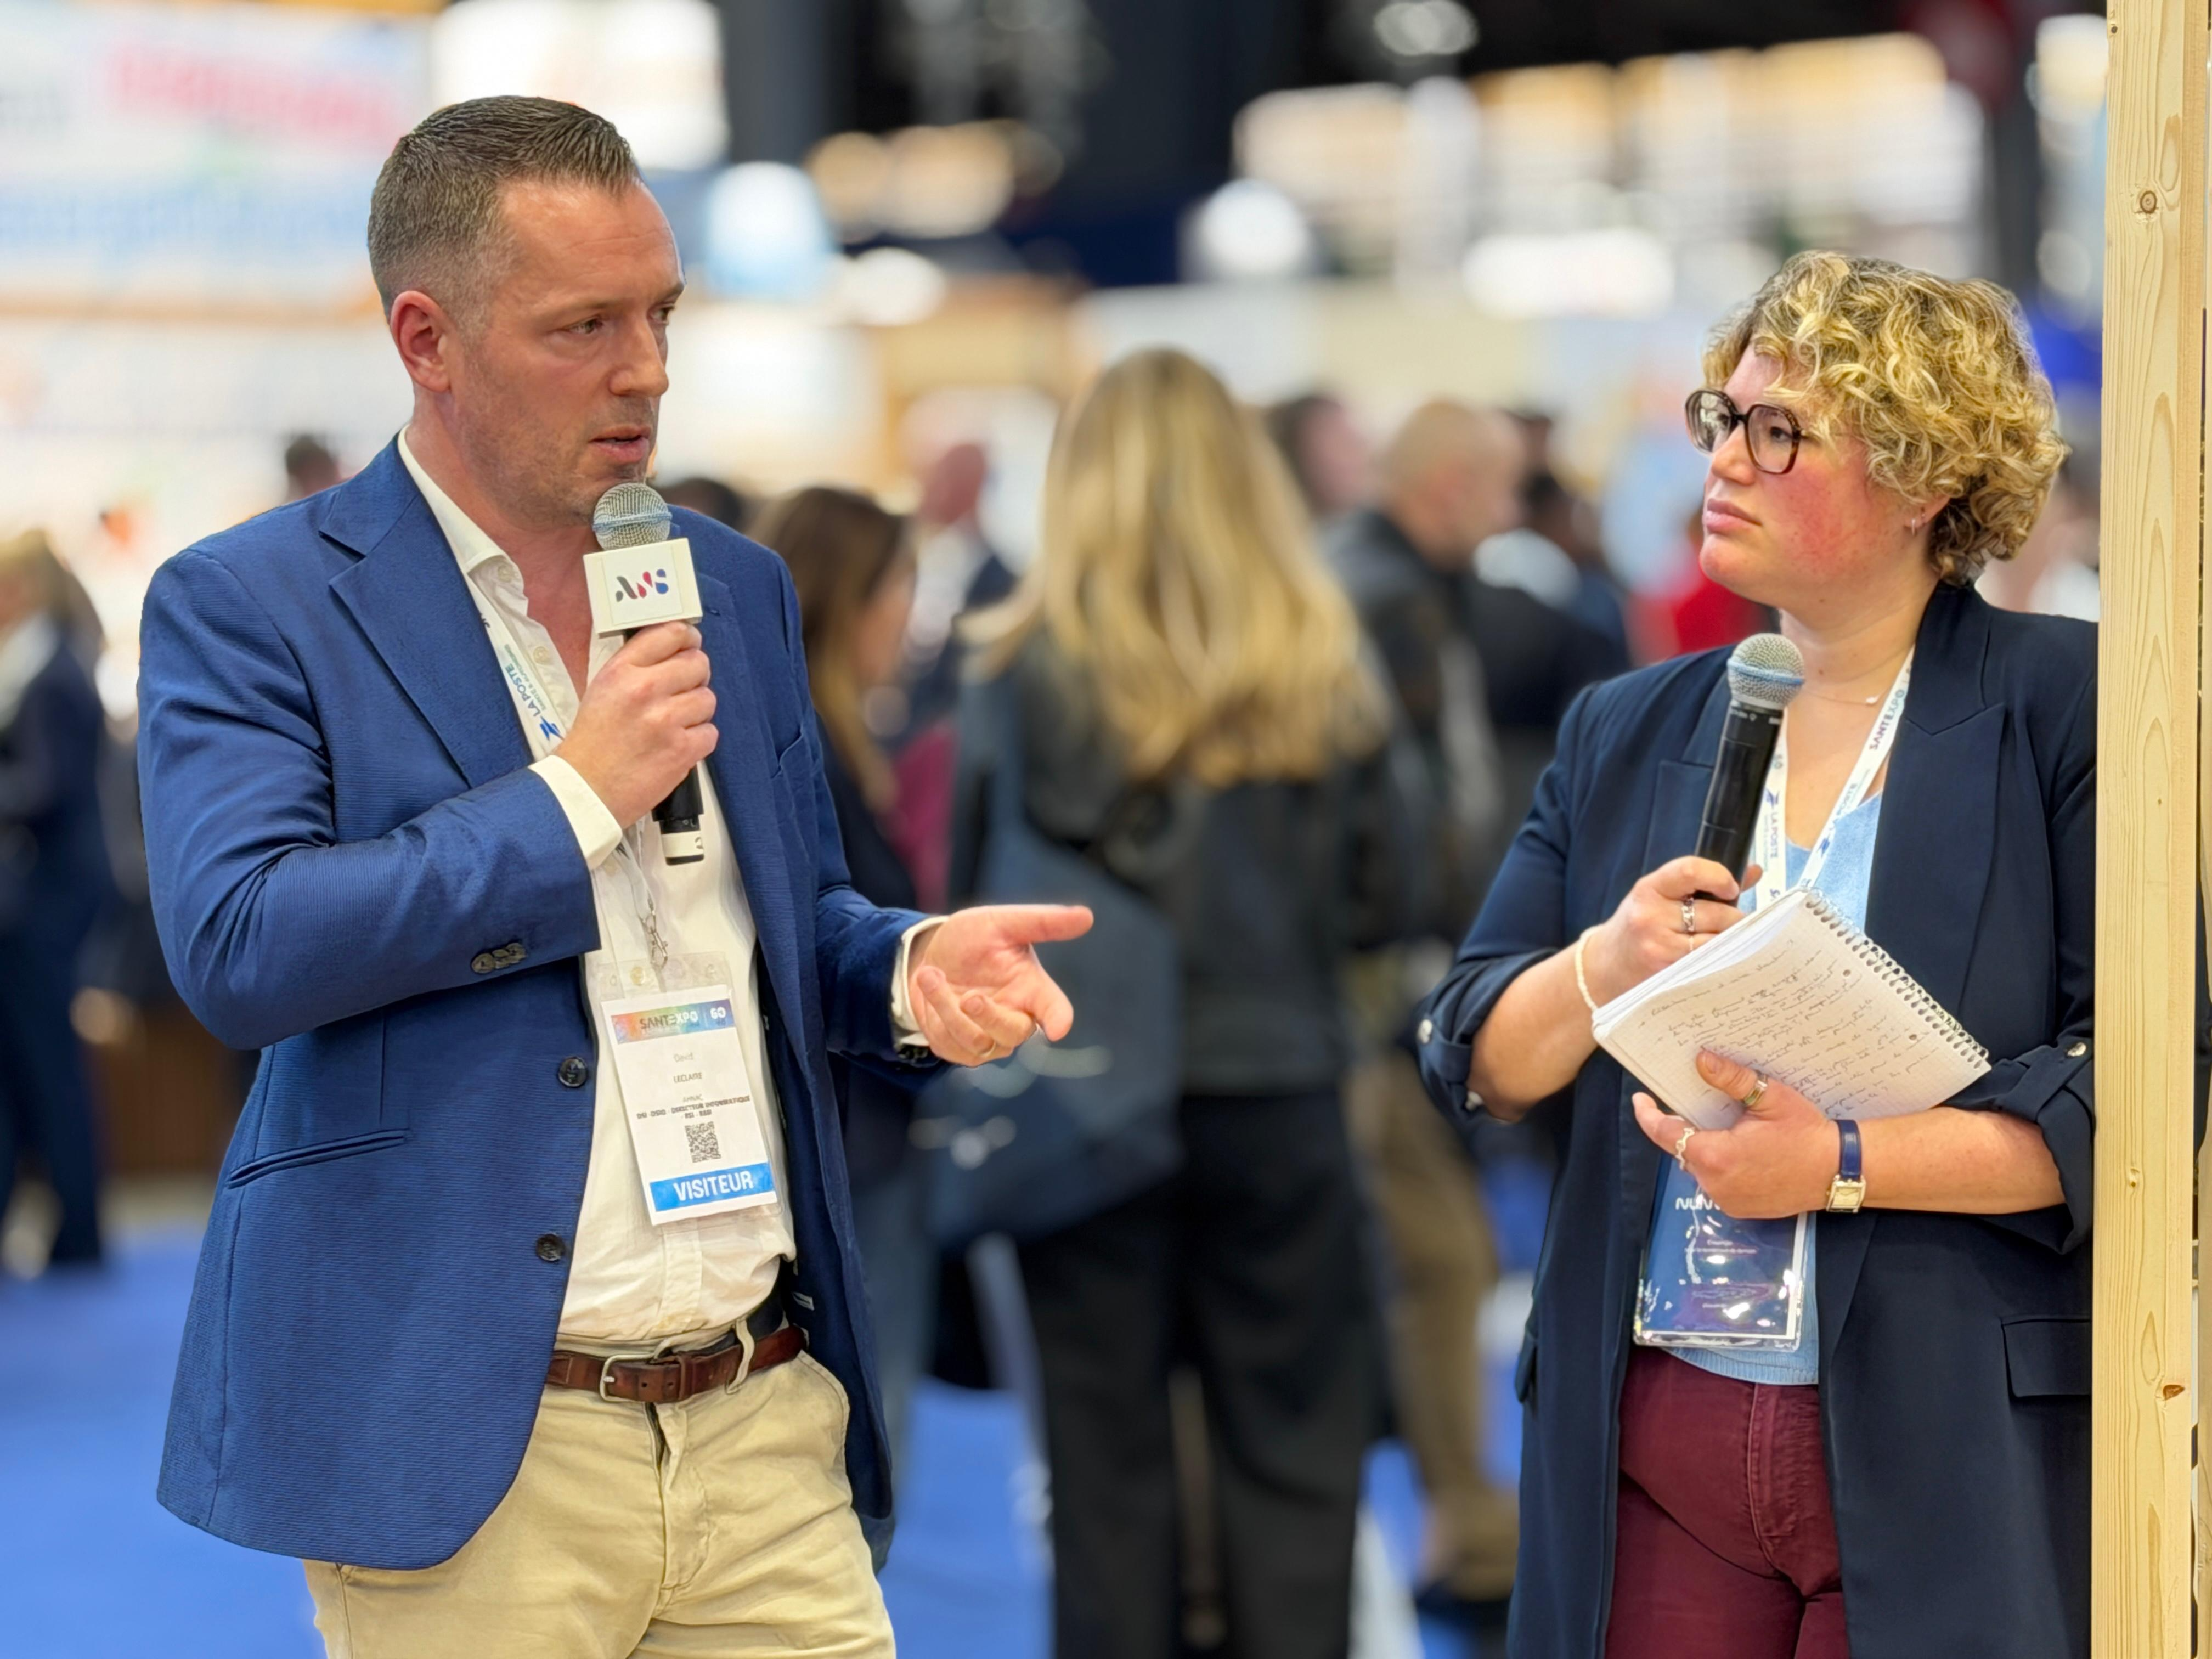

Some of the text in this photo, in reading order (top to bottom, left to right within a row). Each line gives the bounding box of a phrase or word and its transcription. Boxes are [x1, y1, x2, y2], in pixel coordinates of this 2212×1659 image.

[505, 663, 541, 717] LA POSTE
[1770, 812, 1778, 825] LA
[673, 1171, 754, 1201] VISITEUR
